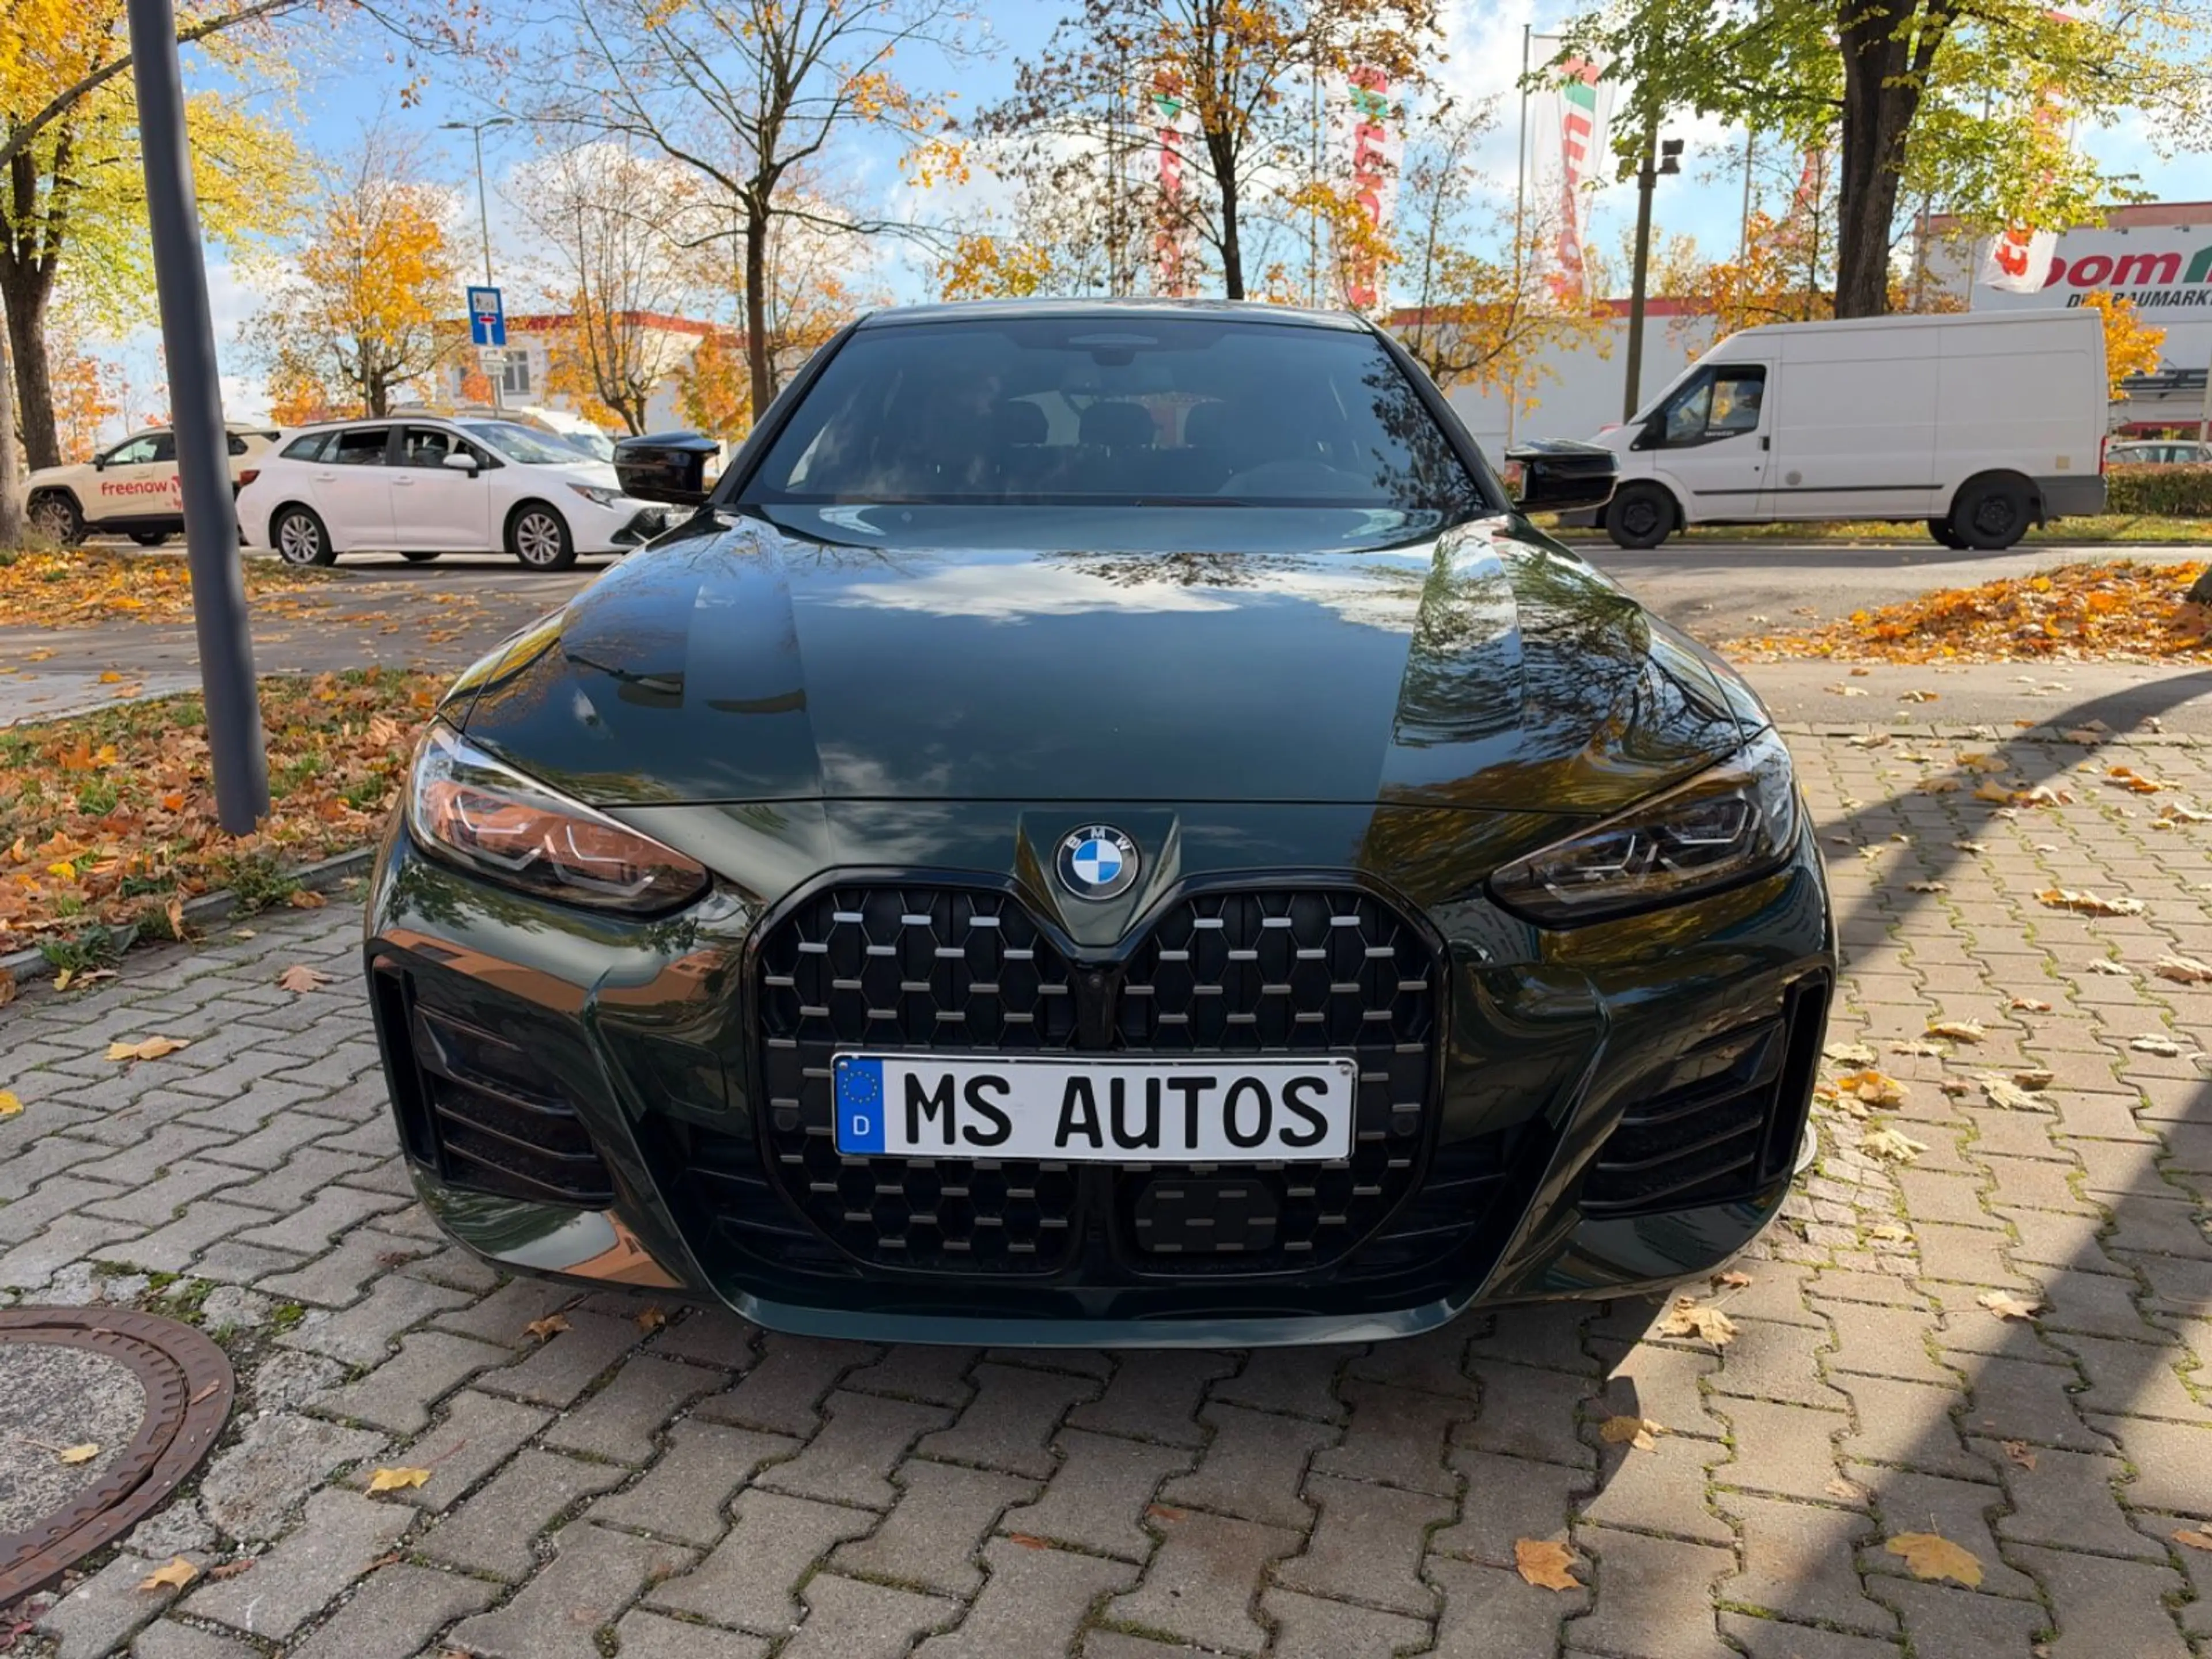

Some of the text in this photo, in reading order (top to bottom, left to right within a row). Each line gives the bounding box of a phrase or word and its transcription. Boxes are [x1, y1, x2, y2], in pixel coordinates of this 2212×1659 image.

[101, 481, 167, 495] freenow
[1066, 827, 1131, 851] BMW
[904, 1073, 1328, 1149] MS AUTOS
[853, 1115, 870, 1135] D
